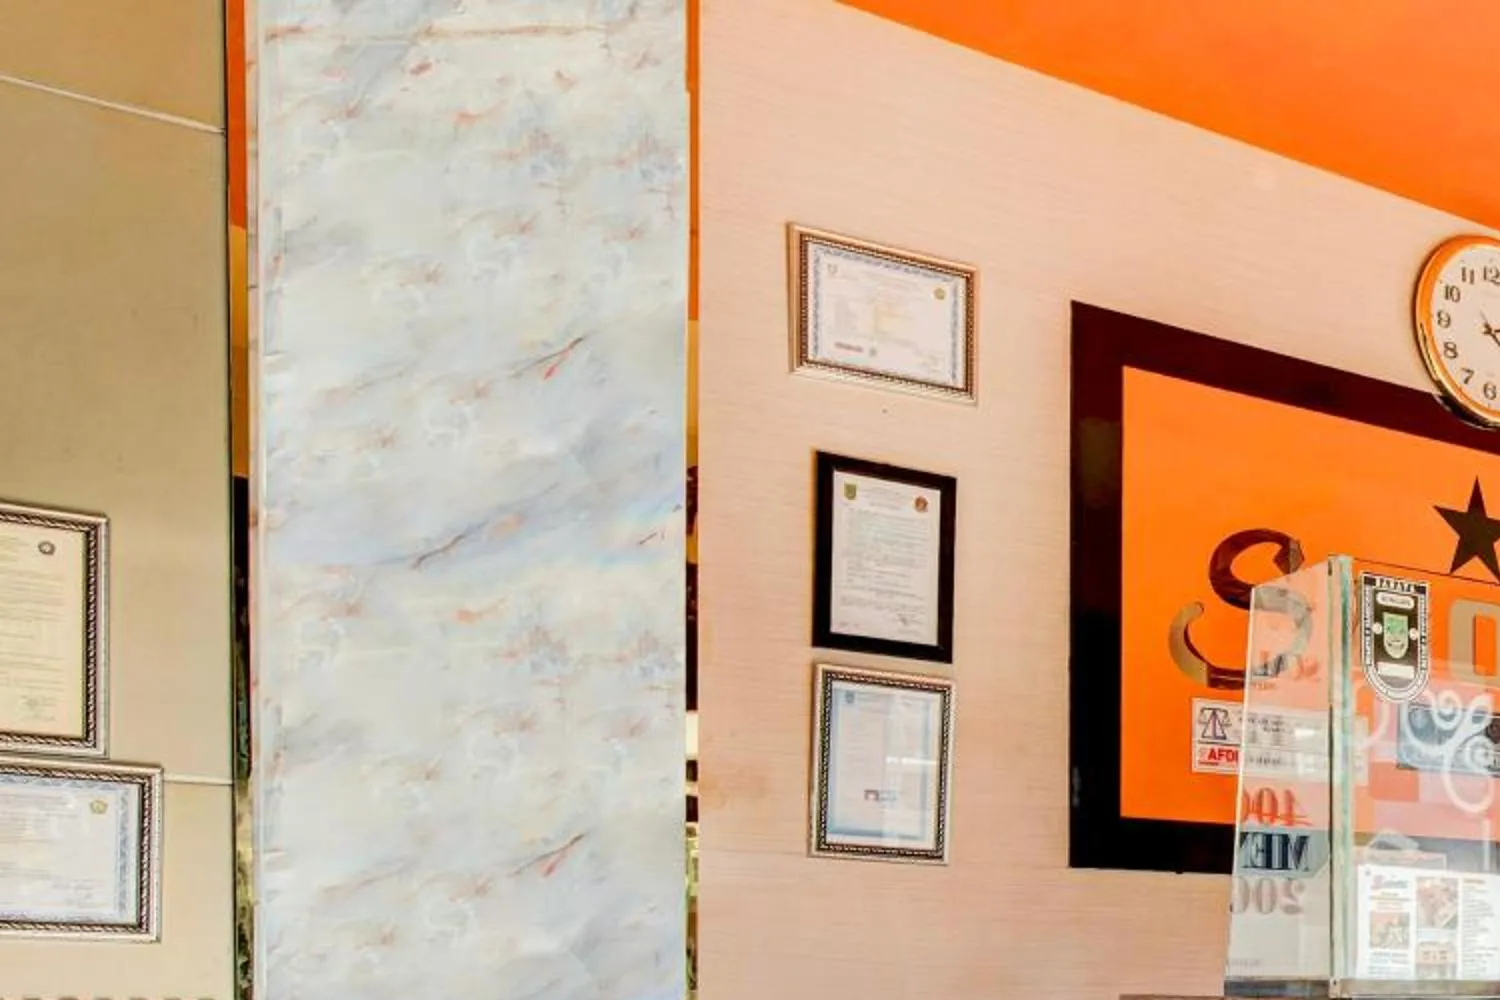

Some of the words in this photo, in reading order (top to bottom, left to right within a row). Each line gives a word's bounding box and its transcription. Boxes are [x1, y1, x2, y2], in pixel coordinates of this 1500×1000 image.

[1461, 266, 1475, 285] 11
[1483, 265, 1500, 286] 12
[1444, 285, 1461, 303] 10
[1437, 310, 1451, 328] 9
[1443, 341, 1458, 359] 8
[1461, 367, 1475, 385] 7
[1483, 382, 1497, 400] 6
